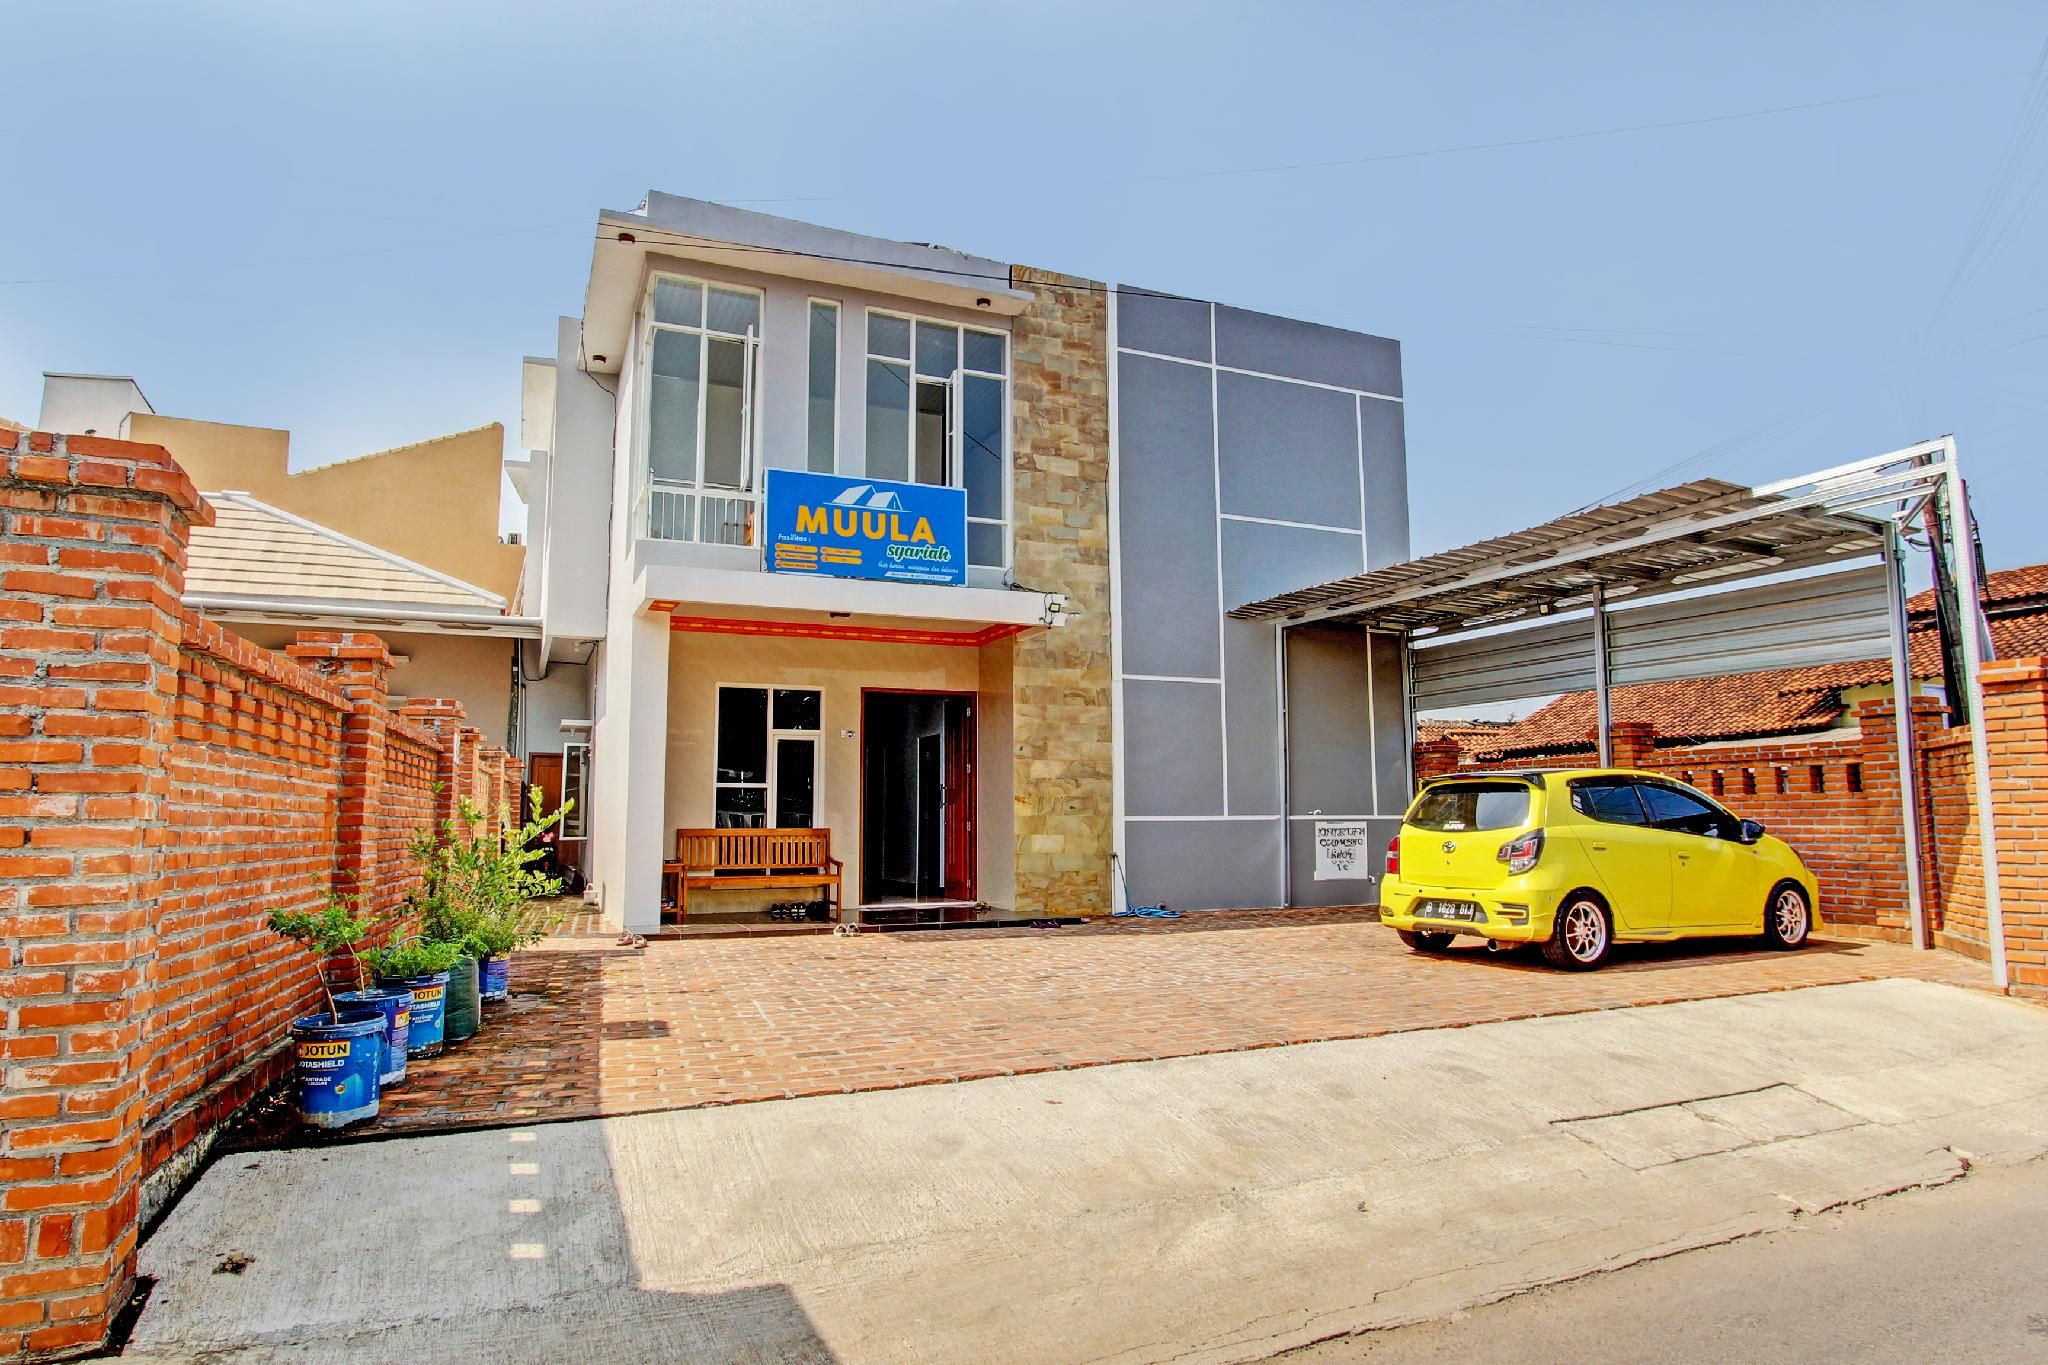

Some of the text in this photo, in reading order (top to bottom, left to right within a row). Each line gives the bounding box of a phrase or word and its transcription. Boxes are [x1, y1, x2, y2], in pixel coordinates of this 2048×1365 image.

[796, 505, 936, 544] MUULA
[887, 544, 951, 562] syariah
[407, 1000, 440, 1010] OTASHIELD
[305, 1043, 347, 1056] JOTUN
